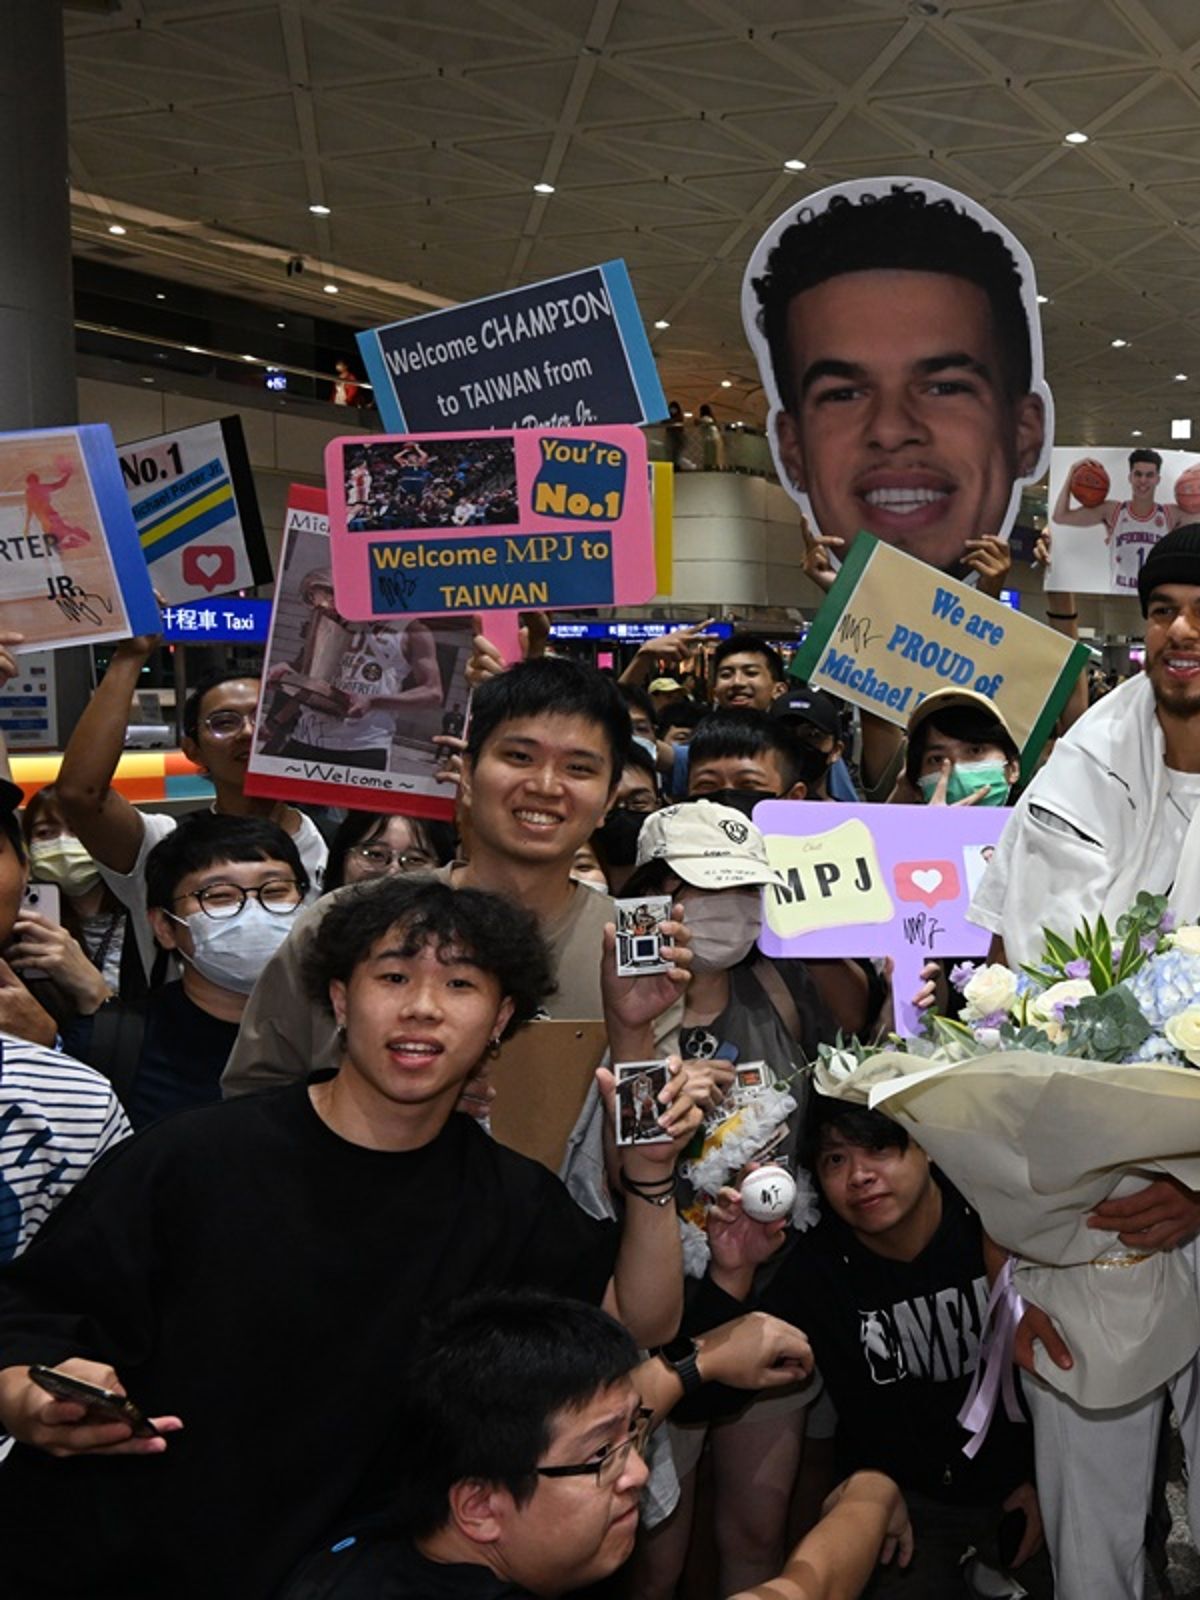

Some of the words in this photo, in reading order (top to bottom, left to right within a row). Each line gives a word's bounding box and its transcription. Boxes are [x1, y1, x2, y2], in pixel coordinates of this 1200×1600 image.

[385, 334, 479, 376] Welcome
[480, 287, 612, 350] CHAMPION
[437, 393, 459, 417] to
[460, 366, 542, 410] TAIWAN
[543, 356, 593, 387] from
[119, 442, 183, 486] No.1
[542, 439, 622, 467] You're
[535, 483, 620, 519] No.1
[289, 513, 330, 534] Mic
[373, 544, 497, 570] Welcome
[505, 536, 575, 563] MPJ
[581, 540, 609, 560] to
[439, 582, 549, 608] TAIWAN
[222, 613, 255, 631] Taxi
[931, 587, 968, 627] We
[965, 612, 1005, 647] are
[819, 649, 913, 712] Michael
[886, 624, 975, 686] PROUD
[974, 671, 1004, 698] of
